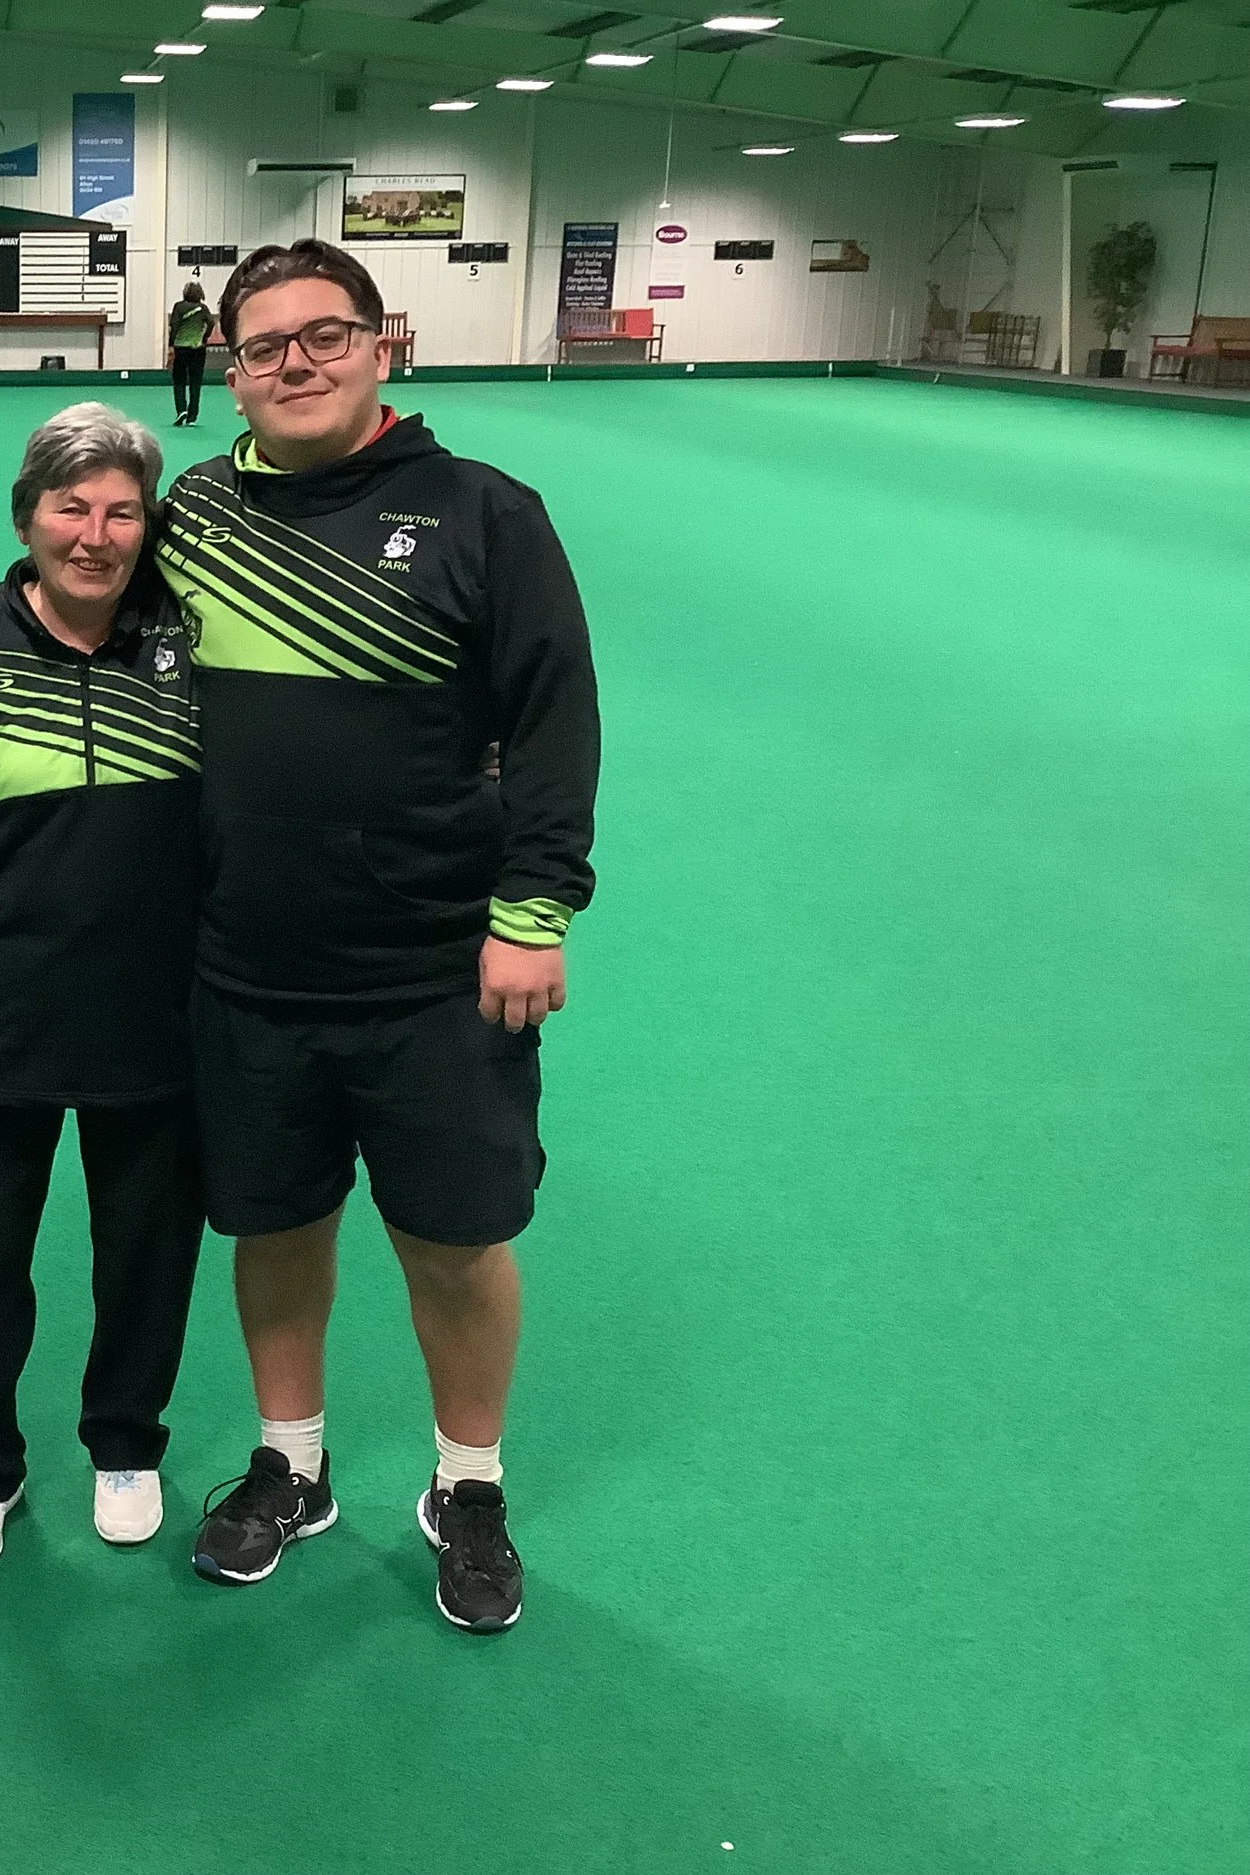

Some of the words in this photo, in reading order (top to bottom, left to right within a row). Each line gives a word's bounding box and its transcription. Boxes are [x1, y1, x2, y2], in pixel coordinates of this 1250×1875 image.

[97, 233, 118, 242] AWAY
[95, 263, 120, 272] TOTAL
[191, 266, 201, 278] 4
[469, 264, 479, 277] 5
[734, 263, 744, 275] 6
[379, 512, 440, 528] CHAWTON
[378, 560, 411, 573] PARK
[153, 670, 181, 682] PARK
